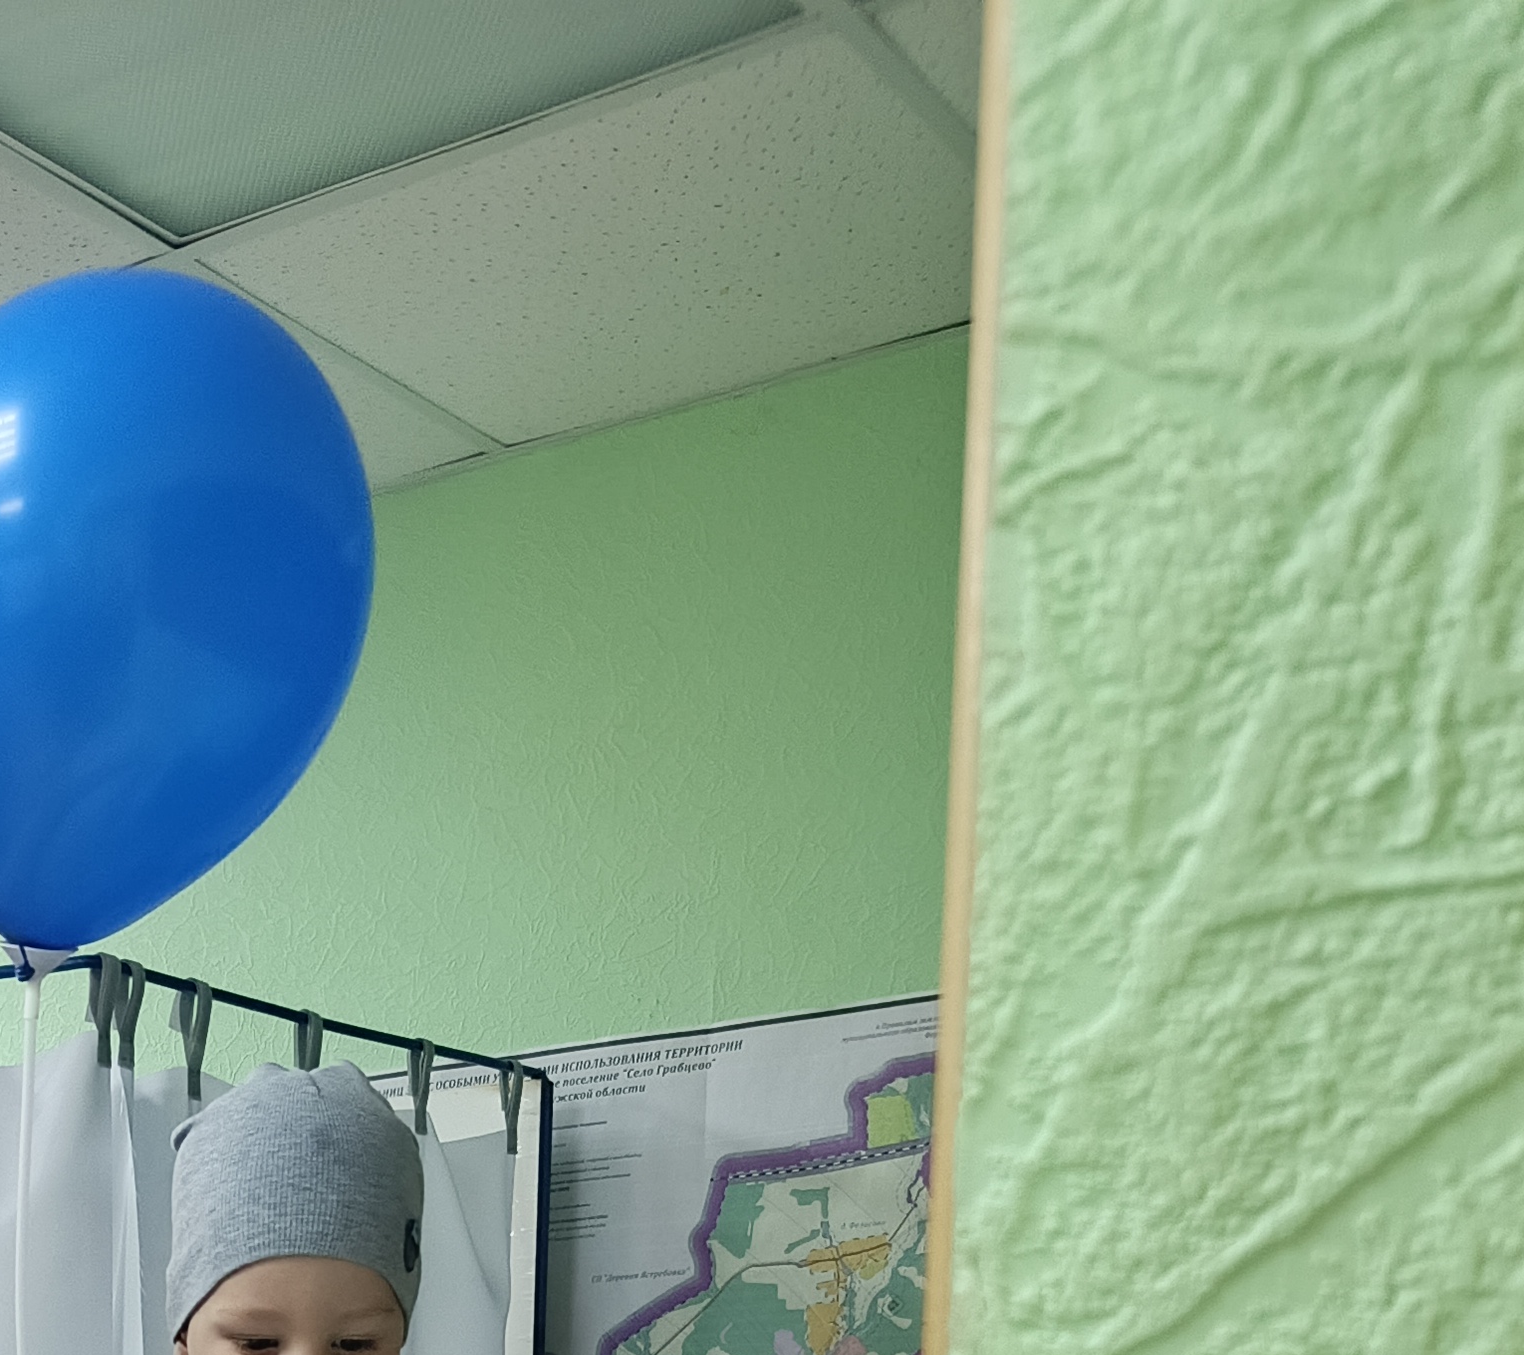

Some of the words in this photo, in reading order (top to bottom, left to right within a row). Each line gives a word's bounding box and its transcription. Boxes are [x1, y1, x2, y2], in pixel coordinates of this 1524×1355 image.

[435, 1074, 491, 1091] ОСОБЫМИ
[561, 1050, 661, 1074] ИСПОЛЬЗОВАНИЯ
[664, 1039, 744, 1060] ТЕРРИТОРИИ
[562, 1072, 620, 1088] поселение
[595, 1083, 646, 1098] области
